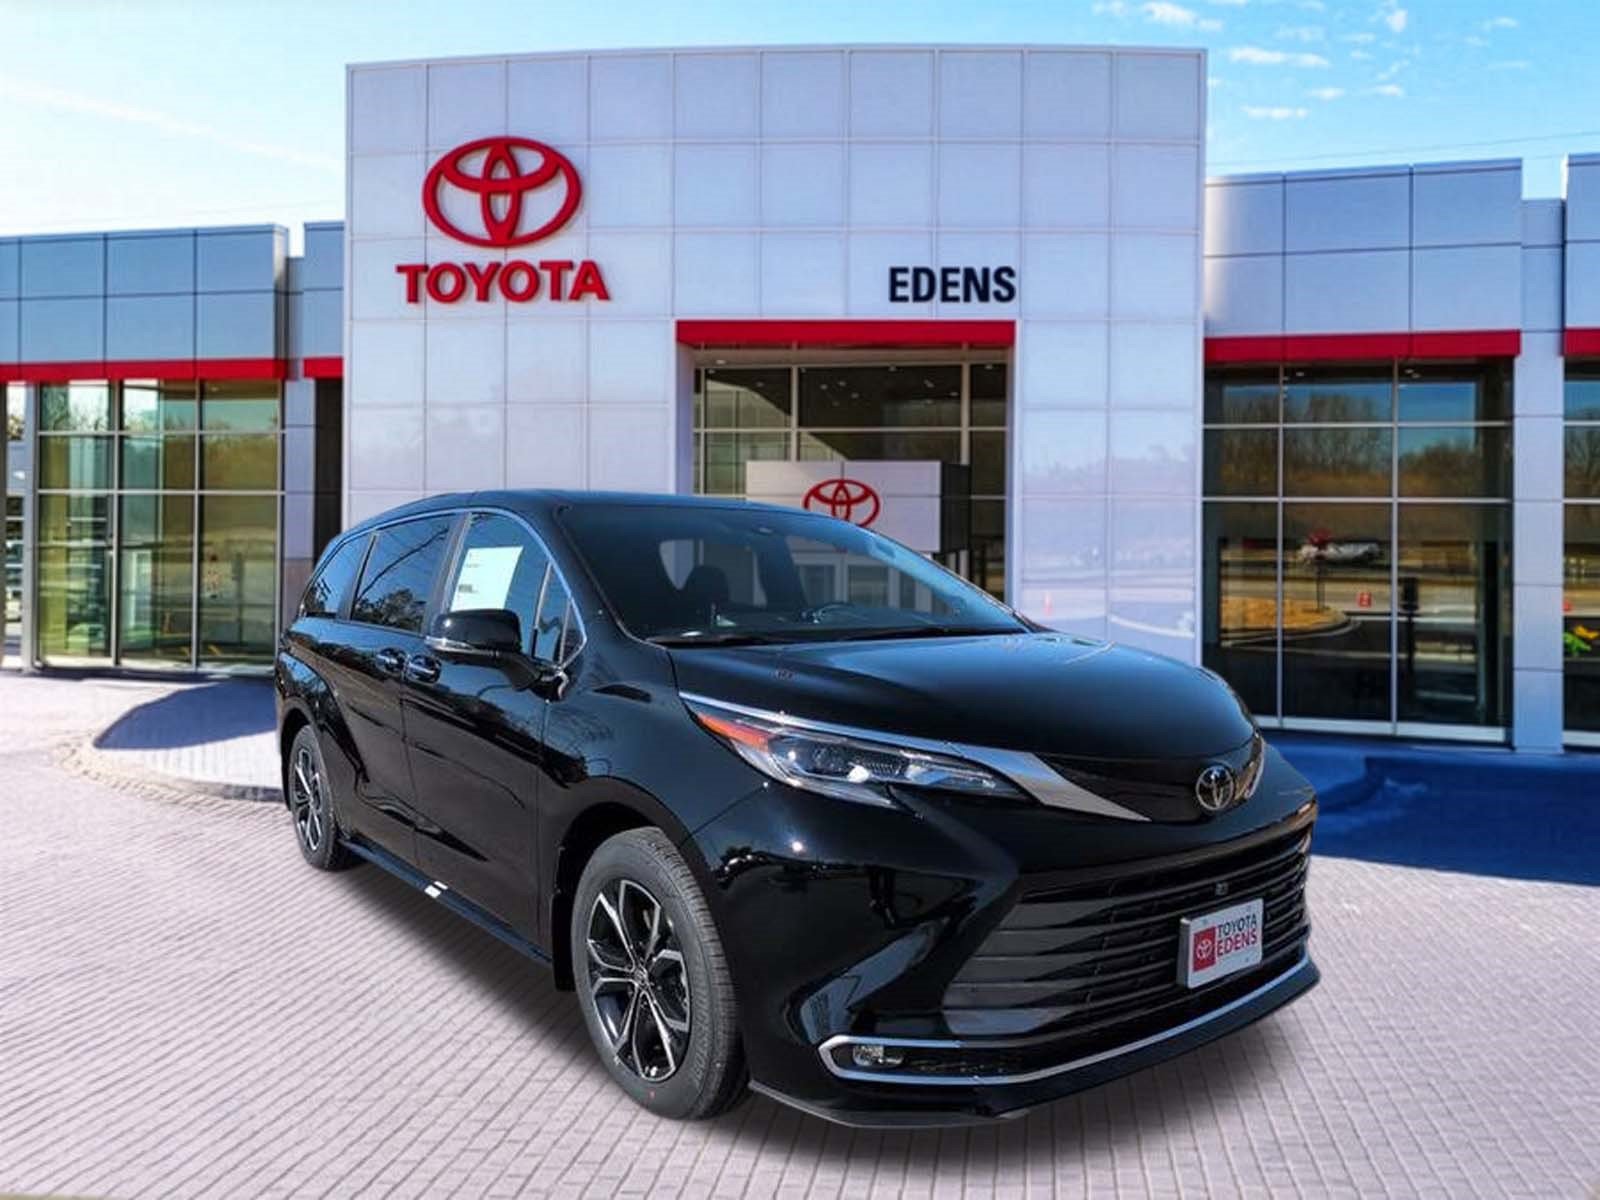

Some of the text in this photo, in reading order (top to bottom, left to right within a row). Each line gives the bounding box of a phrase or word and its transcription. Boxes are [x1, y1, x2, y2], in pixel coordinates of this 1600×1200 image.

[396, 260, 610, 304] TOYOTA
[889, 266, 1016, 303] EDENS
[1216, 914, 1257, 938] TOYOTA
[1217, 928, 1258, 956] EDENS
